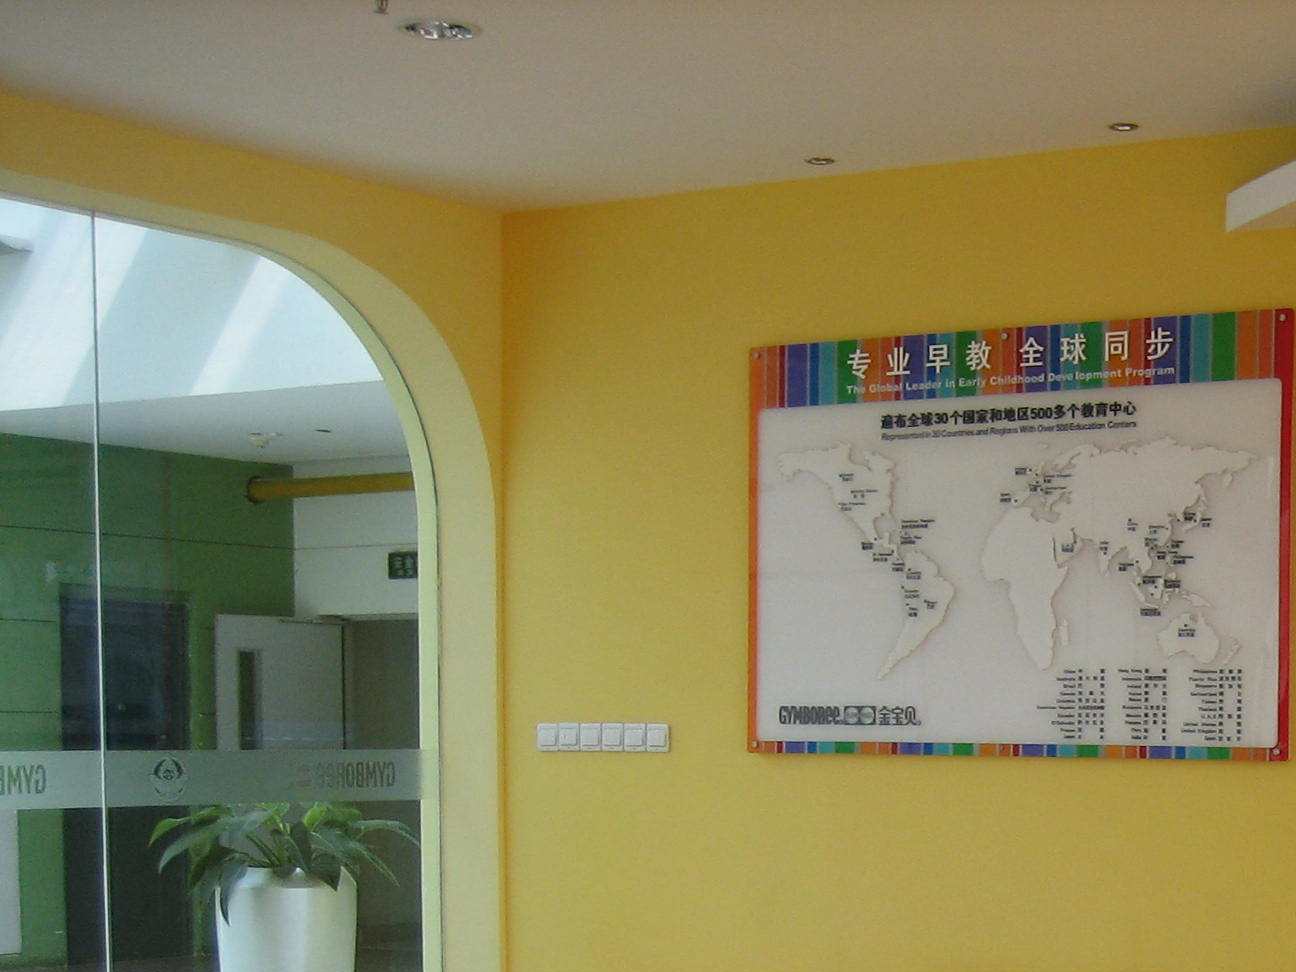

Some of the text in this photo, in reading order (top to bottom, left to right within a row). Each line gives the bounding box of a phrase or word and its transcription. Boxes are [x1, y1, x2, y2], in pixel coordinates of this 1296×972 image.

[846, 326, 1174, 380] 专业早教 全球同步
[847, 385, 865, 395] The
[869, 383, 902, 394] Global
[906, 381, 942, 391] Leader
[959, 376, 985, 389] Early
[990, 373, 1045, 386] Childhood
[1048, 368, 1122, 383] Development
[1125, 366, 1175, 380] Program
